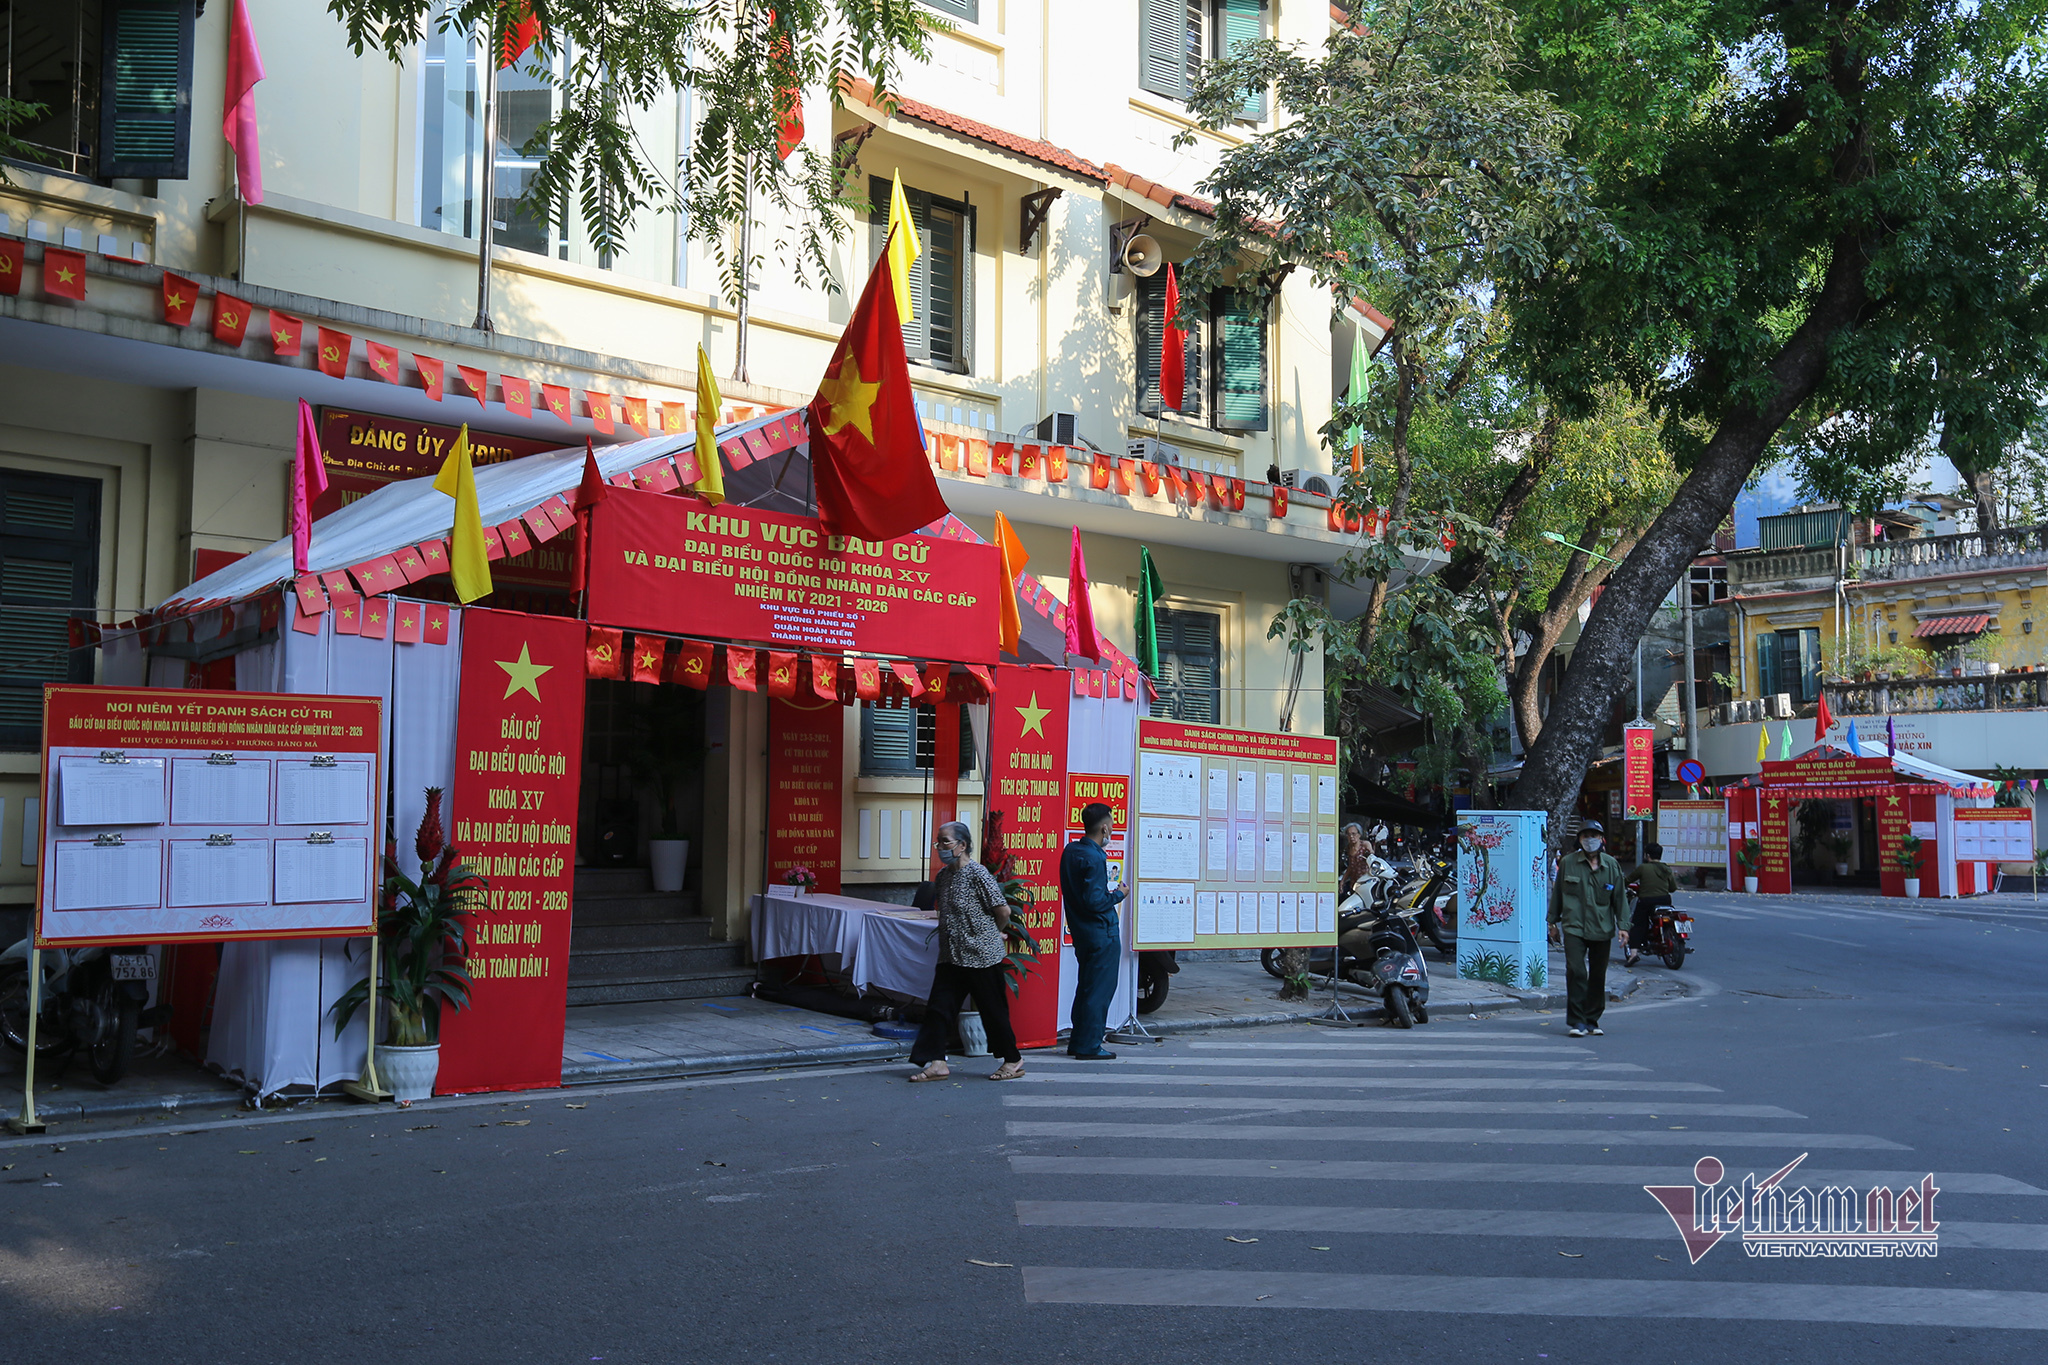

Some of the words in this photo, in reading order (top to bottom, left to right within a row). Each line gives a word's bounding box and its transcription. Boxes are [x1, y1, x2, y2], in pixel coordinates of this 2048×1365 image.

[350, 421, 407, 452] ĐẢNG
[417, 428, 445, 458] ỦY
[347, 458, 364, 469] Địa
[388, 463, 400, 472] 45
[686, 511, 750, 539] KHU
[760, 522, 818, 549] VỰC
[892, 540, 931, 564] CỬ
[684, 539, 715, 557] ĐẠI
[721, 543, 762, 562] BIỂU
[768, 551, 814, 569] QUỐC
[819, 557, 846, 575] HỘI
[851, 562, 893, 580] KHÓA
[897, 569, 931, 584] XV
[623, 549, 649, 566] VÀ
[654, 555, 686, 572] ĐẠI
[692, 558, 734, 577] BIỂU
[739, 565, 768, 584] HỘI
[774, 569, 821, 588] ĐỒNG
[826, 576, 871, 595] NHÂN
[876, 582, 909, 600] DÂN
[913, 588, 943, 604] CÁC
[947, 591, 977, 607] CẤP
[734, 582, 782, 602] NHIỆM
[787, 587, 806, 605] KỲ
[809, 593, 842, 608] 2021
[856, 598, 889, 613] 2026
[760, 603, 779, 611] KHU
[782, 606, 800, 614] VỰC
[802, 607, 815, 615] BỎ
[817, 609, 844, 619] PHIẾU
[846, 612, 858, 620] SỐ
[773, 614, 812, 624] PHƯỜNG
[814, 618, 839, 627] HÀNG
[771, 632, 802, 641] THÀNH
[804, 634, 823, 643] PHỐ
[839, 638, 856, 647] NỘI
[774, 623, 800, 632] QUẬN
[802, 626, 828, 635] HOÀN
[829, 628, 853, 637] KIẾM
[106, 702, 132, 712] NƠI
[137, 702, 173, 714] NIÊM
[177, 701, 203, 715] YẾT
[207, 706, 246, 716] DANH
[250, 705, 287, 718] SÁCH
[290, 706, 310, 718] CỬ
[313, 709, 333, 719] TRI
[69, 715, 82, 729] BẦU
[84, 714, 94, 730] CỬ
[94, 718, 105, 732] ĐẠI
[107, 715, 122, 730] BIỂU
[123, 716, 140, 731] QUỐC
[141, 718, 152, 733] HỘI
[153, 718, 170, 731] KHÓA
[172, 721, 181, 732] XV
[181, 719, 189, 732] VÀ
[190, 721, 201, 734] ĐẠI
[202, 718, 216, 733] BIỂU
[217, 720, 228, 735] HỘI
[229, 719, 245, 734] ĐỒNG
[246, 721, 263, 734] NHÂN
[263, 721, 276, 734] DÂN
[290, 720, 302, 735] CẤP
[302, 723, 321, 738] NHIỆM
[331, 726, 345, 736] 2021
[349, 726, 363, 737] 2026
[501, 712, 523, 739] BẦU
[525, 714, 541, 741] CỬ
[1184, 729, 1200, 737] DANH
[1201, 729, 1216, 739] SÁCH
[144, 737, 163, 746] VỰC
[180, 736, 209, 745] PHIẾU
[277, 739, 302, 747] HÀNG
[1917, 742, 1932, 750] XIN
[469, 750, 488, 775] ĐẠI
[491, 744, 516, 772] BIỂU
[518, 747, 546, 775] QUỐC
[548, 751, 566, 779] HỘI
[1010, 748, 1020, 768] CỬ
[1020, 753, 1030, 769] TRI
[1031, 751, 1040, 769] HÀ
[1041, 751, 1052, 773] NỘI
[488, 785, 517, 809] KHÓA
[520, 790, 545, 810] XV
[1001, 776, 1015, 795] TÍCH
[1016, 778, 1029, 799] CỰC
[1030, 780, 1048, 796] THAM
[1049, 781, 1059, 796] GIA
[1074, 781, 1099, 798] KHU
[1102, 782, 1125, 802] VỰC
[1017, 801, 1031, 822] BẦU
[1032, 801, 1042, 822] CỬ
[457, 817, 471, 842] VÀ
[473, 822, 492, 847] ĐẠI
[495, 815, 519, 843] BIỂU
[522, 819, 540, 848] HỘI
[542, 818, 571, 844] ĐỒNG
[1010, 826, 1026, 849] BIỂU
[1026, 827, 1044, 850] QUỐC
[1046, 830, 1057, 852] HỘI
[494, 852, 516, 876] DÂN
[519, 853, 540, 877] CÁC
[543, 851, 564, 877] CẤP
[1028, 860, 1043, 875] XV
[490, 886, 505, 910] KỲ
[507, 891, 532, 910] 2021
[542, 891, 568, 910] 2026
[1041, 880, 1059, 901] ĐỒNG
[1042, 906, 1055, 927] CẤP
[476, 920, 489, 944] LÀ
[492, 920, 521, 944] NGÀY
[523, 920, 542, 948] HỘI
[1039, 938, 1054, 954] 2026
[115, 967, 154, 979] 752.86
[465, 952, 486, 979] CỦA
[490, 954, 517, 978] TOÀN
[520, 953, 542, 977] DÂN
